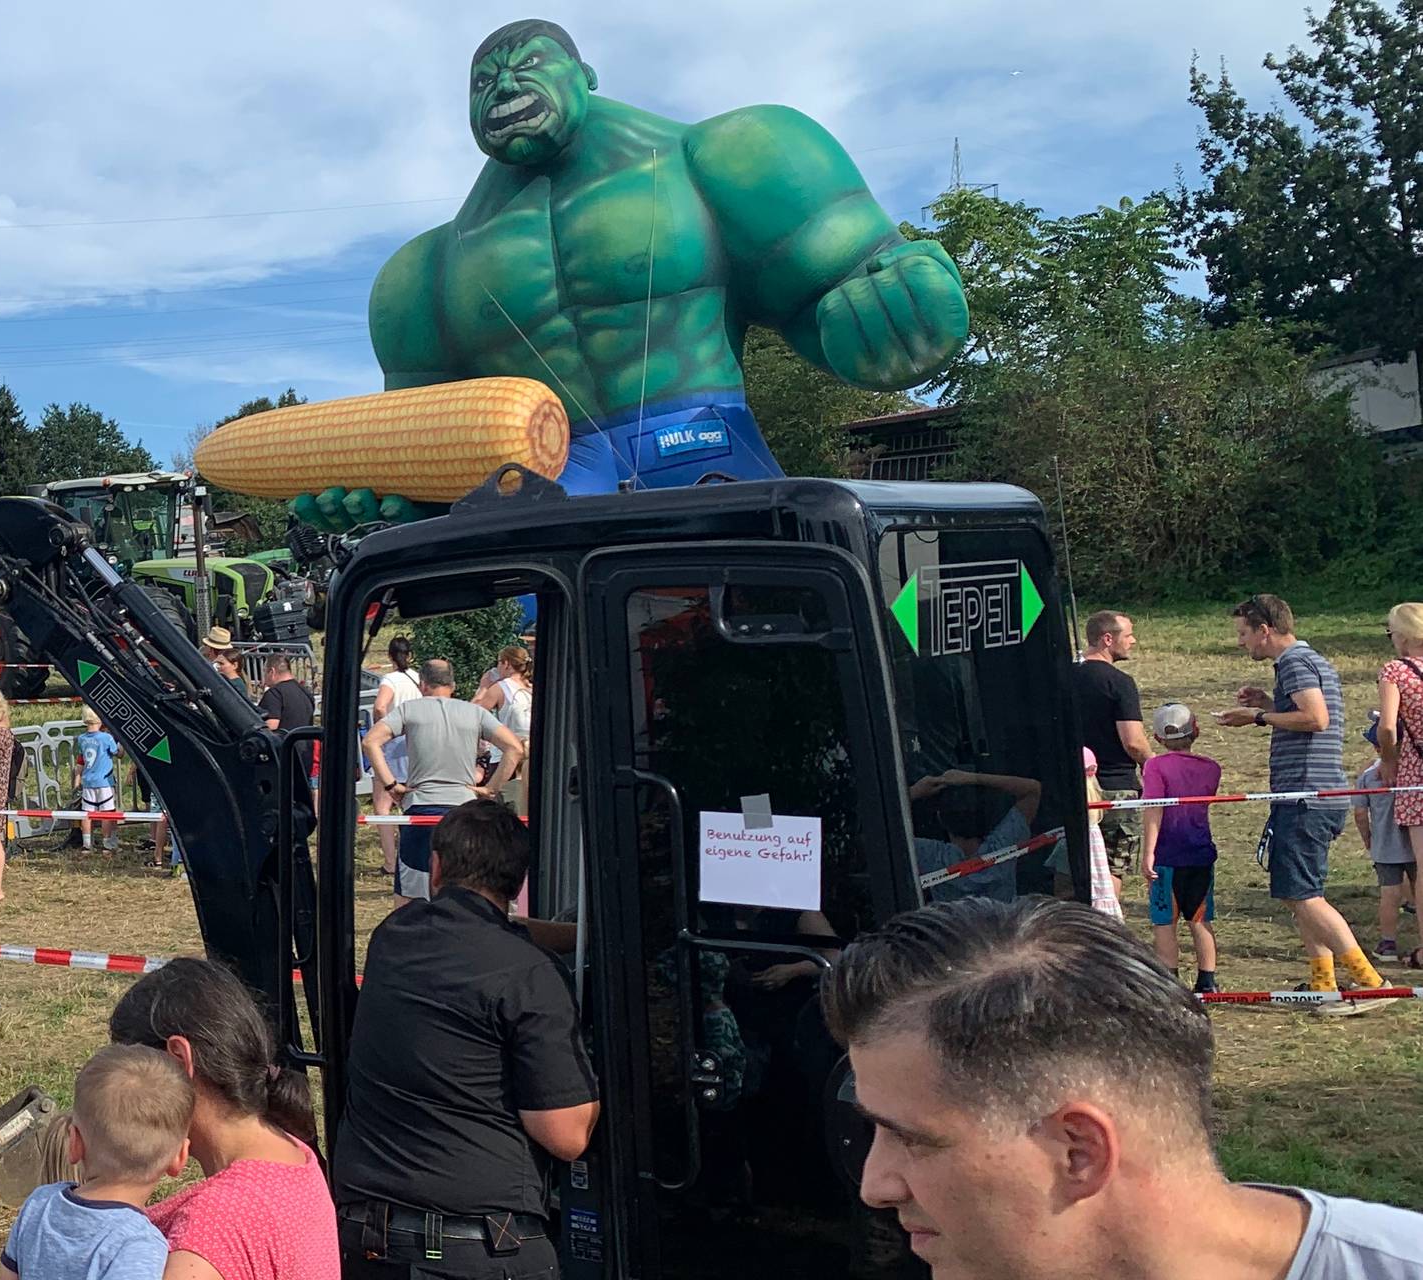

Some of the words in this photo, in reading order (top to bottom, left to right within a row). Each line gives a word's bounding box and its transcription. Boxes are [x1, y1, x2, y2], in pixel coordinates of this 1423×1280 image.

[659, 430, 696, 449] HULK
[920, 558, 1021, 657] TEPEL
[88, 669, 165, 753] TEPEL
[86, 748, 97, 769] 9
[706, 828, 782, 847] Benutzung
[787, 831, 812, 847] auf
[705, 845, 752, 861] eigene
[757, 848, 813, 863] Gefahr!
